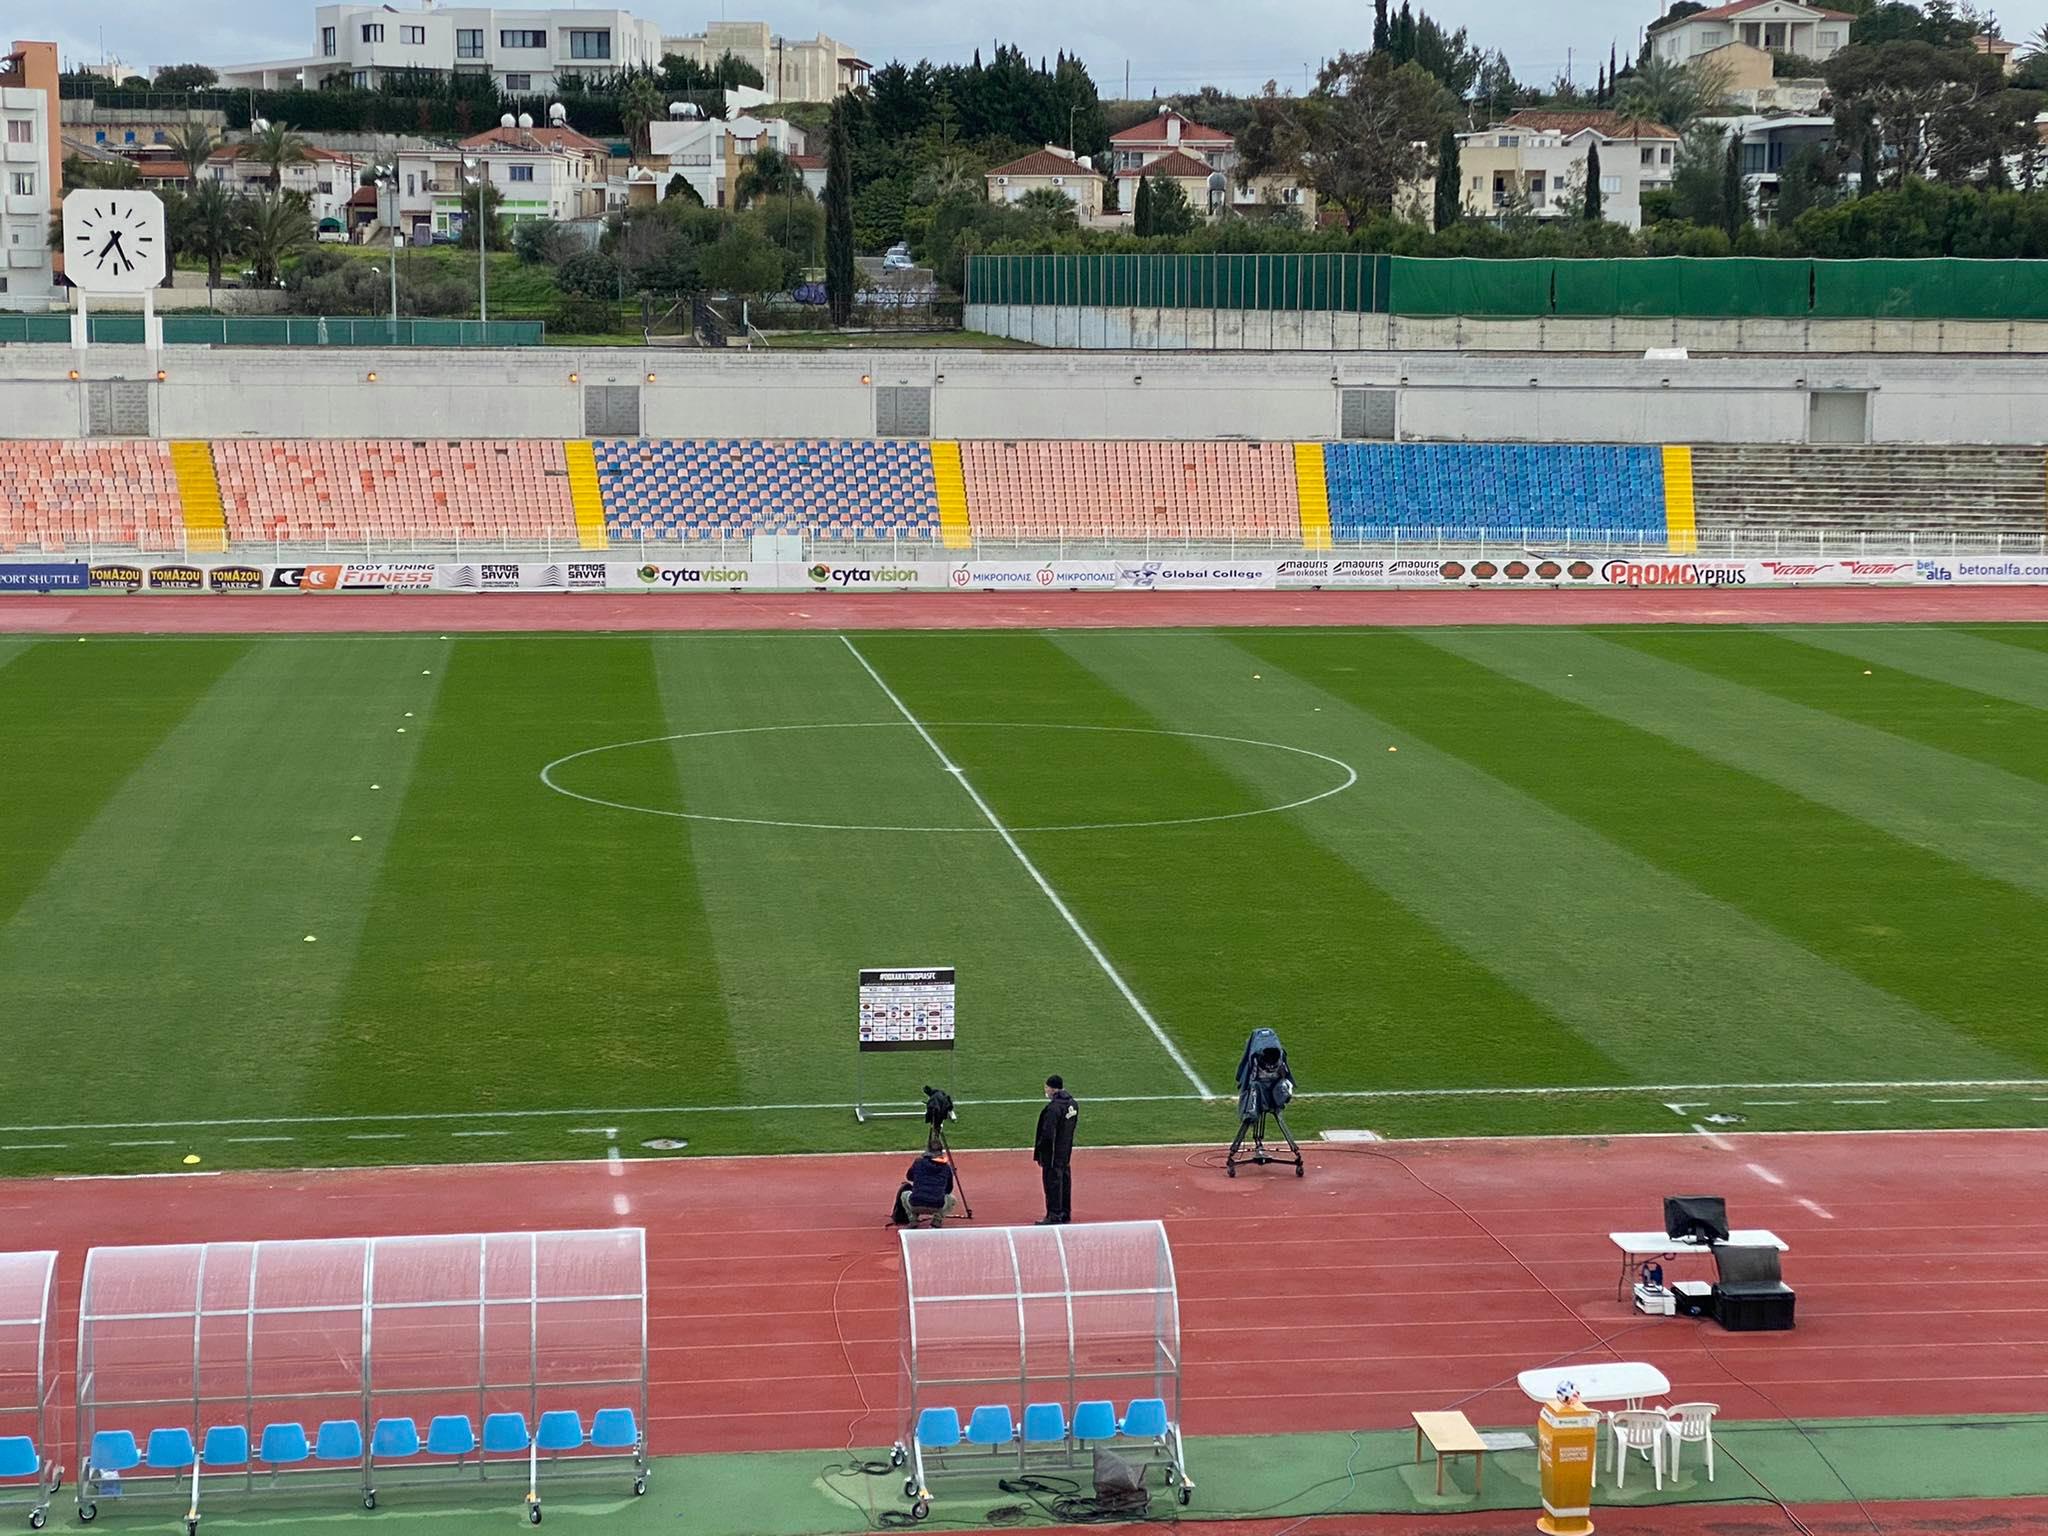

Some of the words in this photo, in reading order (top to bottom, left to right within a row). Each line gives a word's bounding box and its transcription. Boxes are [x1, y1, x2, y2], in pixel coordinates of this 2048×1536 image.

[1286, 560, 1328, 569] maouris
[1342, 560, 1384, 569] maouris
[1398, 560, 1440, 569] maouris
[1917, 560, 1935, 570] bet
[29, 574, 79, 584] SHUTTLE
[91, 569, 139, 580] TOMAZOU
[152, 569, 200, 580] TOMAZOU
[212, 570, 260, 581] TOMAZOU
[344, 571, 433, 582] FITNESS
[661, 565, 748, 586] cytavision
[832, 565, 918, 586] cytavision
[1162, 569, 1208, 578] Global
[1213, 569, 1263, 579] College
[1926, 567, 1951, 580] alfa
